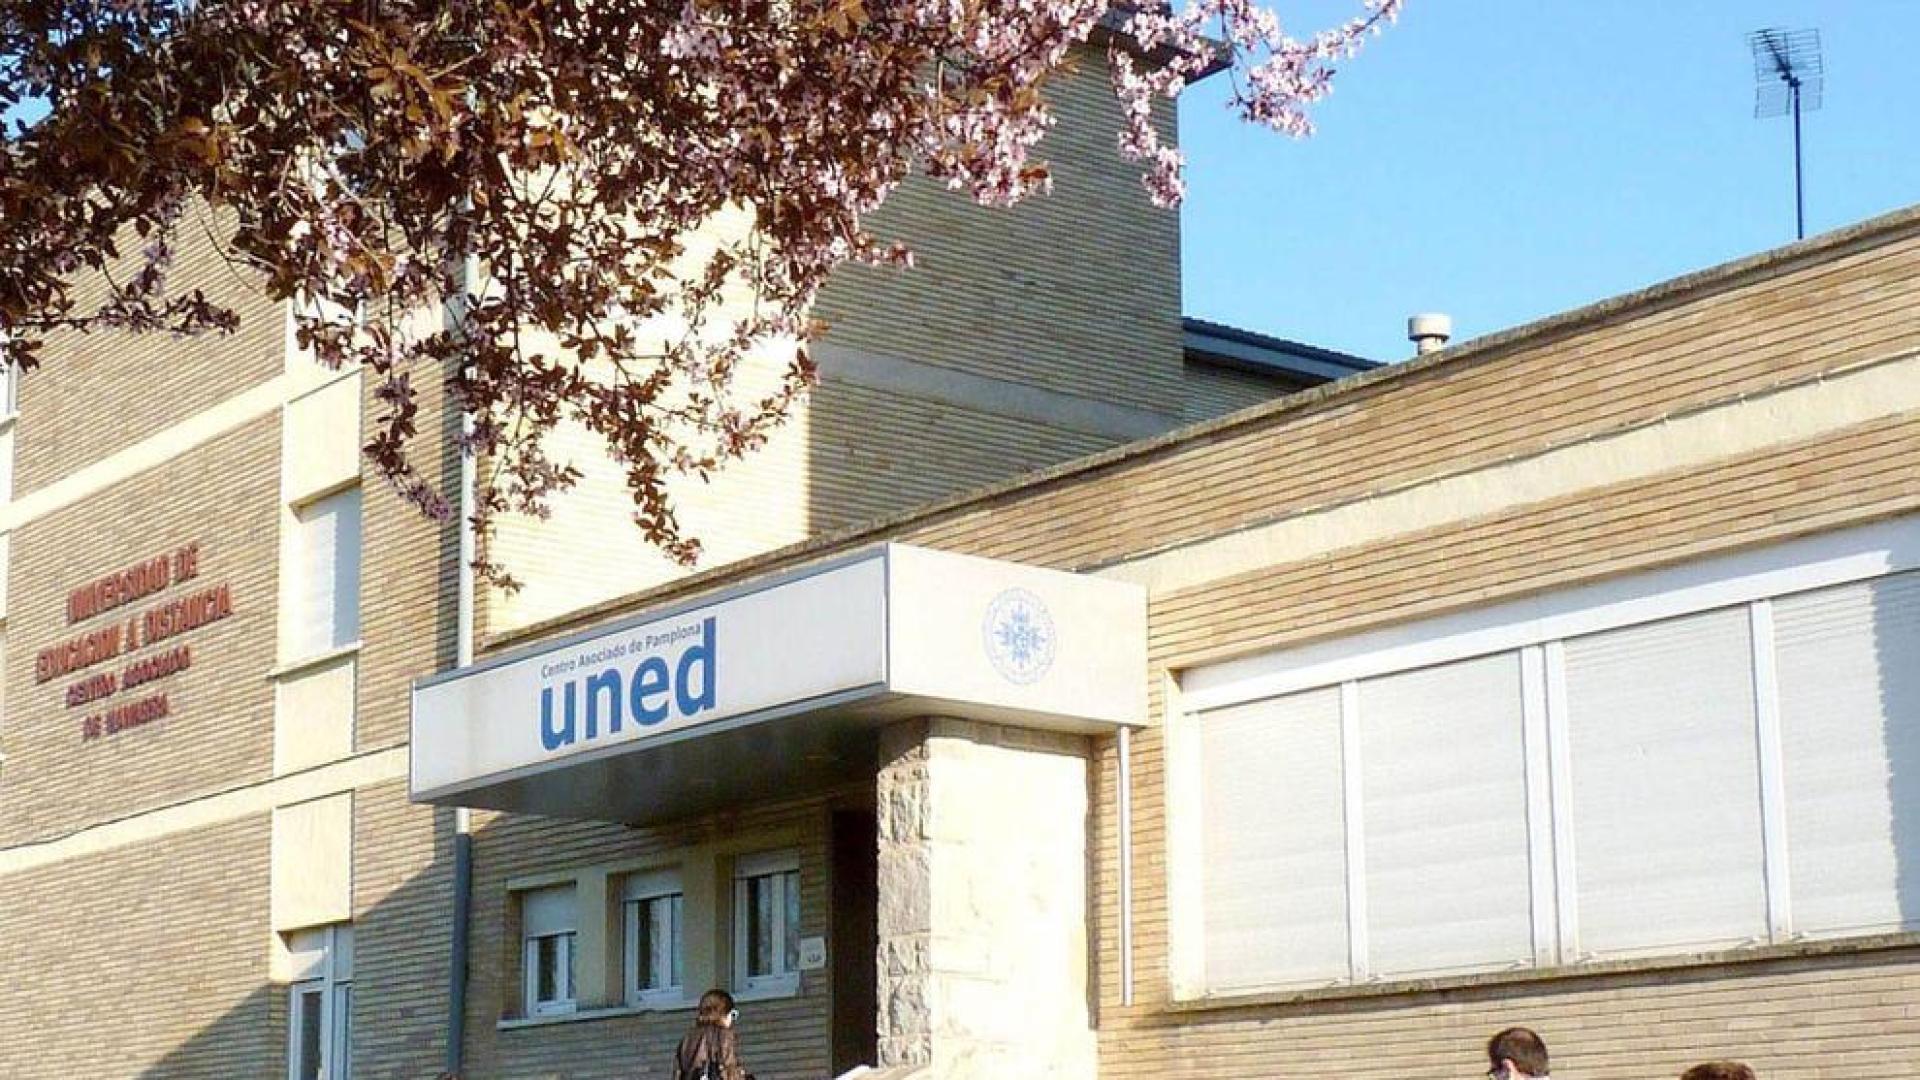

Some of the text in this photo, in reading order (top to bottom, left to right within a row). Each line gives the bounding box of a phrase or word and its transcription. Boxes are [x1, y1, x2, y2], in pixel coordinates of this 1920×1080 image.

[541, 624, 701, 679] Centro Asociado de Pamplona
[542, 616, 717, 751] uned
